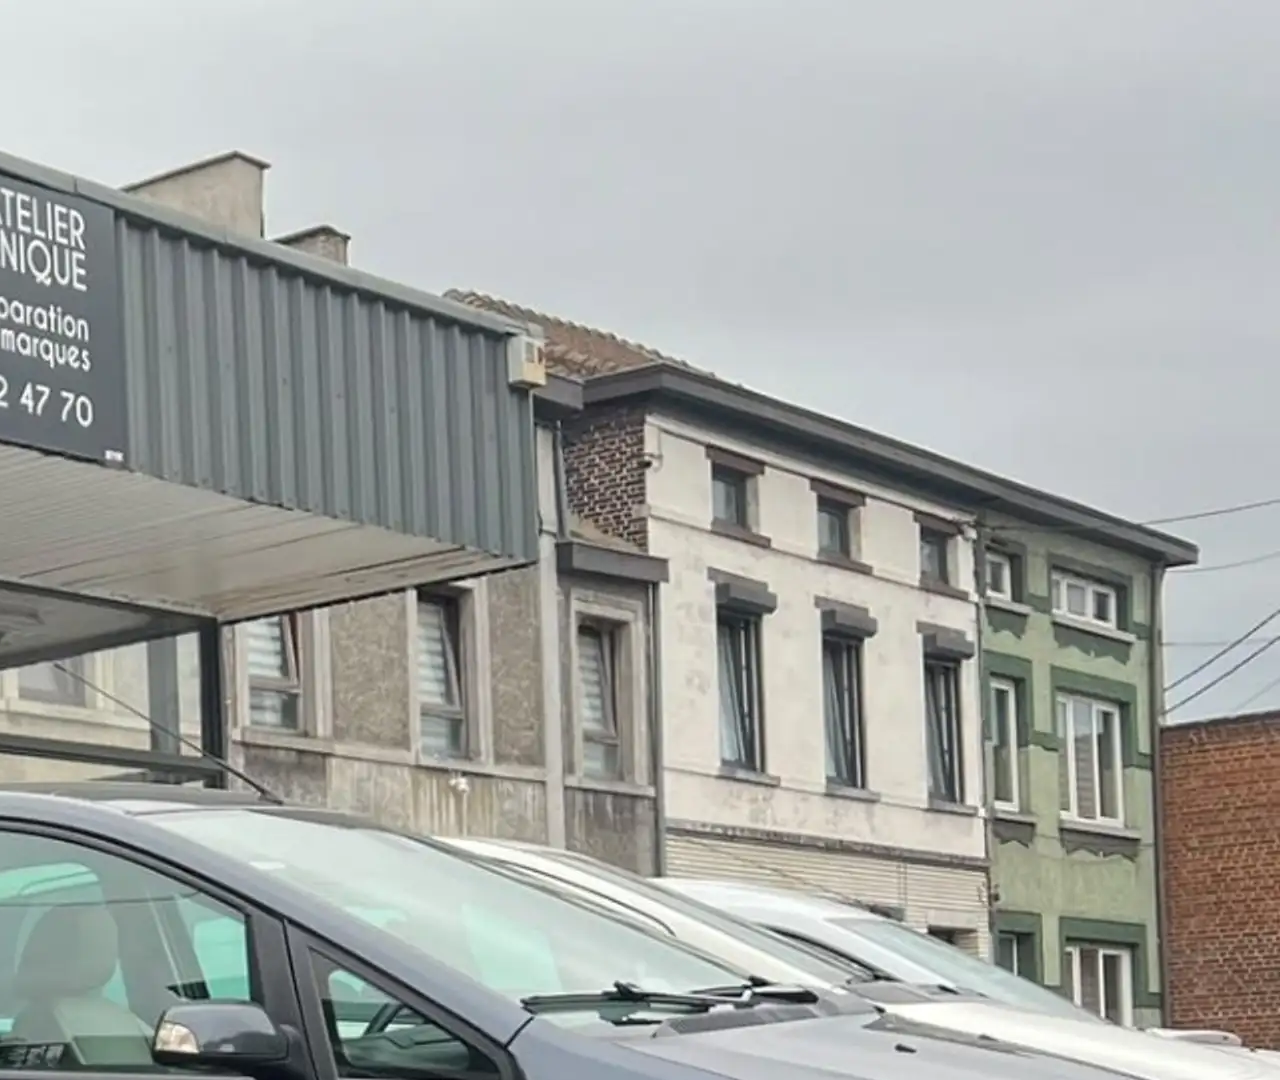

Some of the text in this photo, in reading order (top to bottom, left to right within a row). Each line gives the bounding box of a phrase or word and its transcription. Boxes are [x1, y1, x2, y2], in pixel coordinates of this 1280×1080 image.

[0, 328, 91, 372] marques
[20, 381, 50, 416] 47
[59, 391, 93, 428] 70
